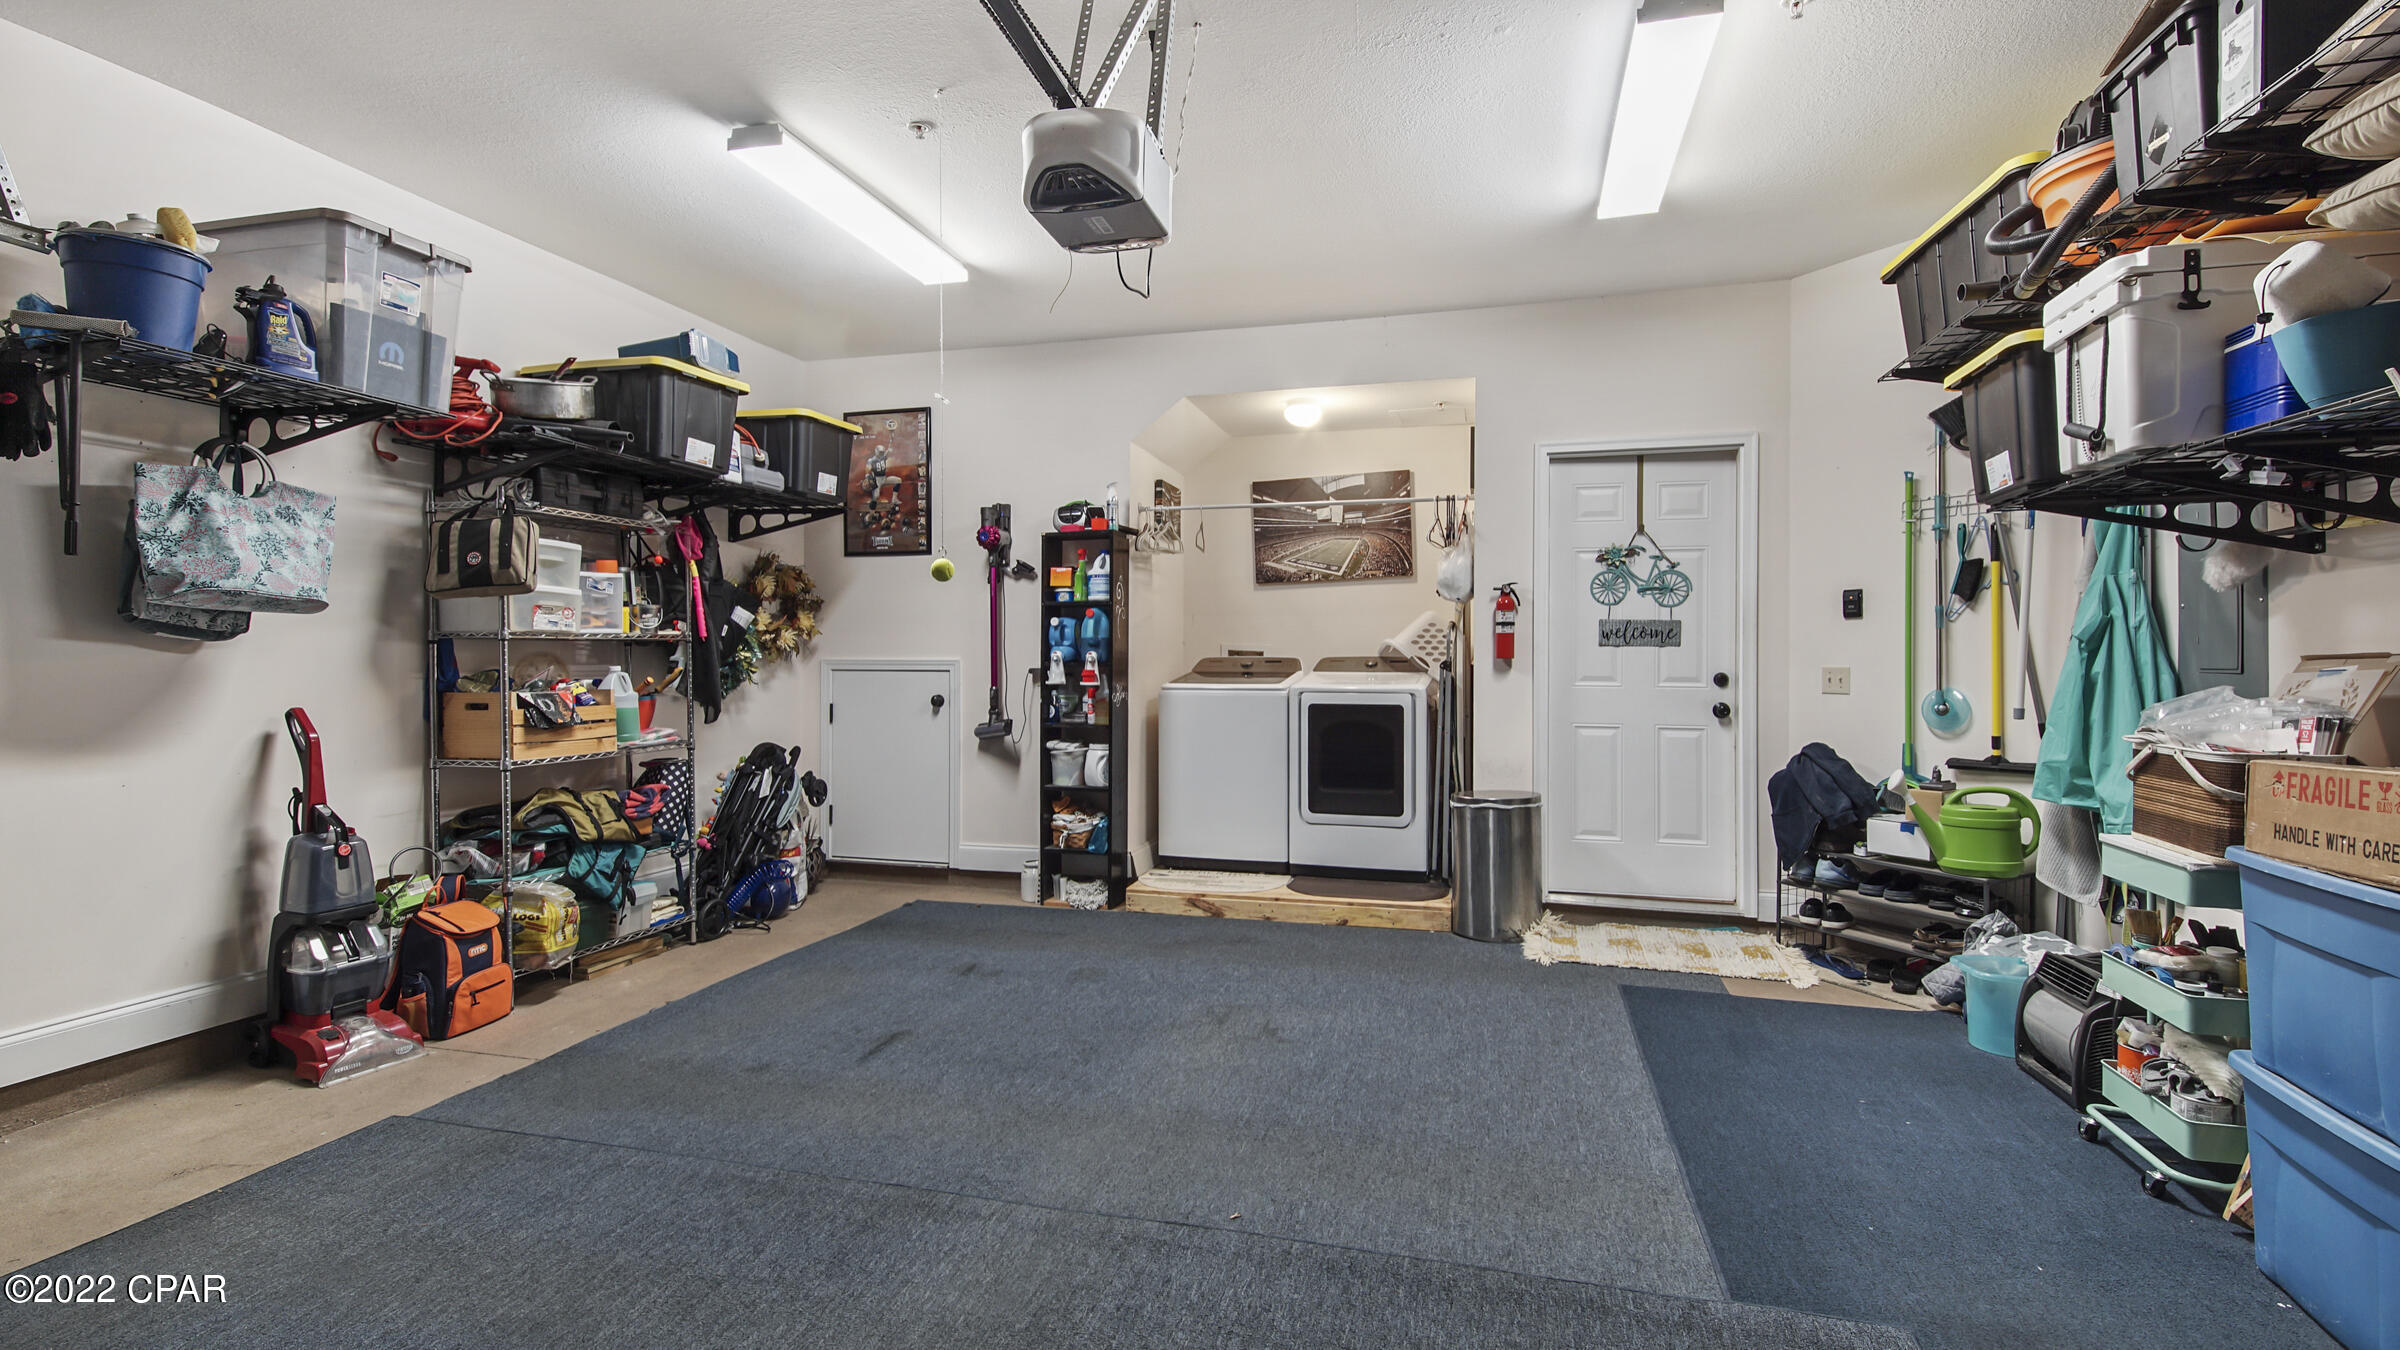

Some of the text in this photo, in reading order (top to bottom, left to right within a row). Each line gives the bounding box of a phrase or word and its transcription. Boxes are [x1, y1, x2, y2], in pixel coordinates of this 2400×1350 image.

[270, 314, 287, 324] Raid
[1602, 620, 1677, 644] welcome
[2286, 772, 2371, 811] FRAGILE
[2273, 823, 2400, 864] HANDLE WITH CARE
